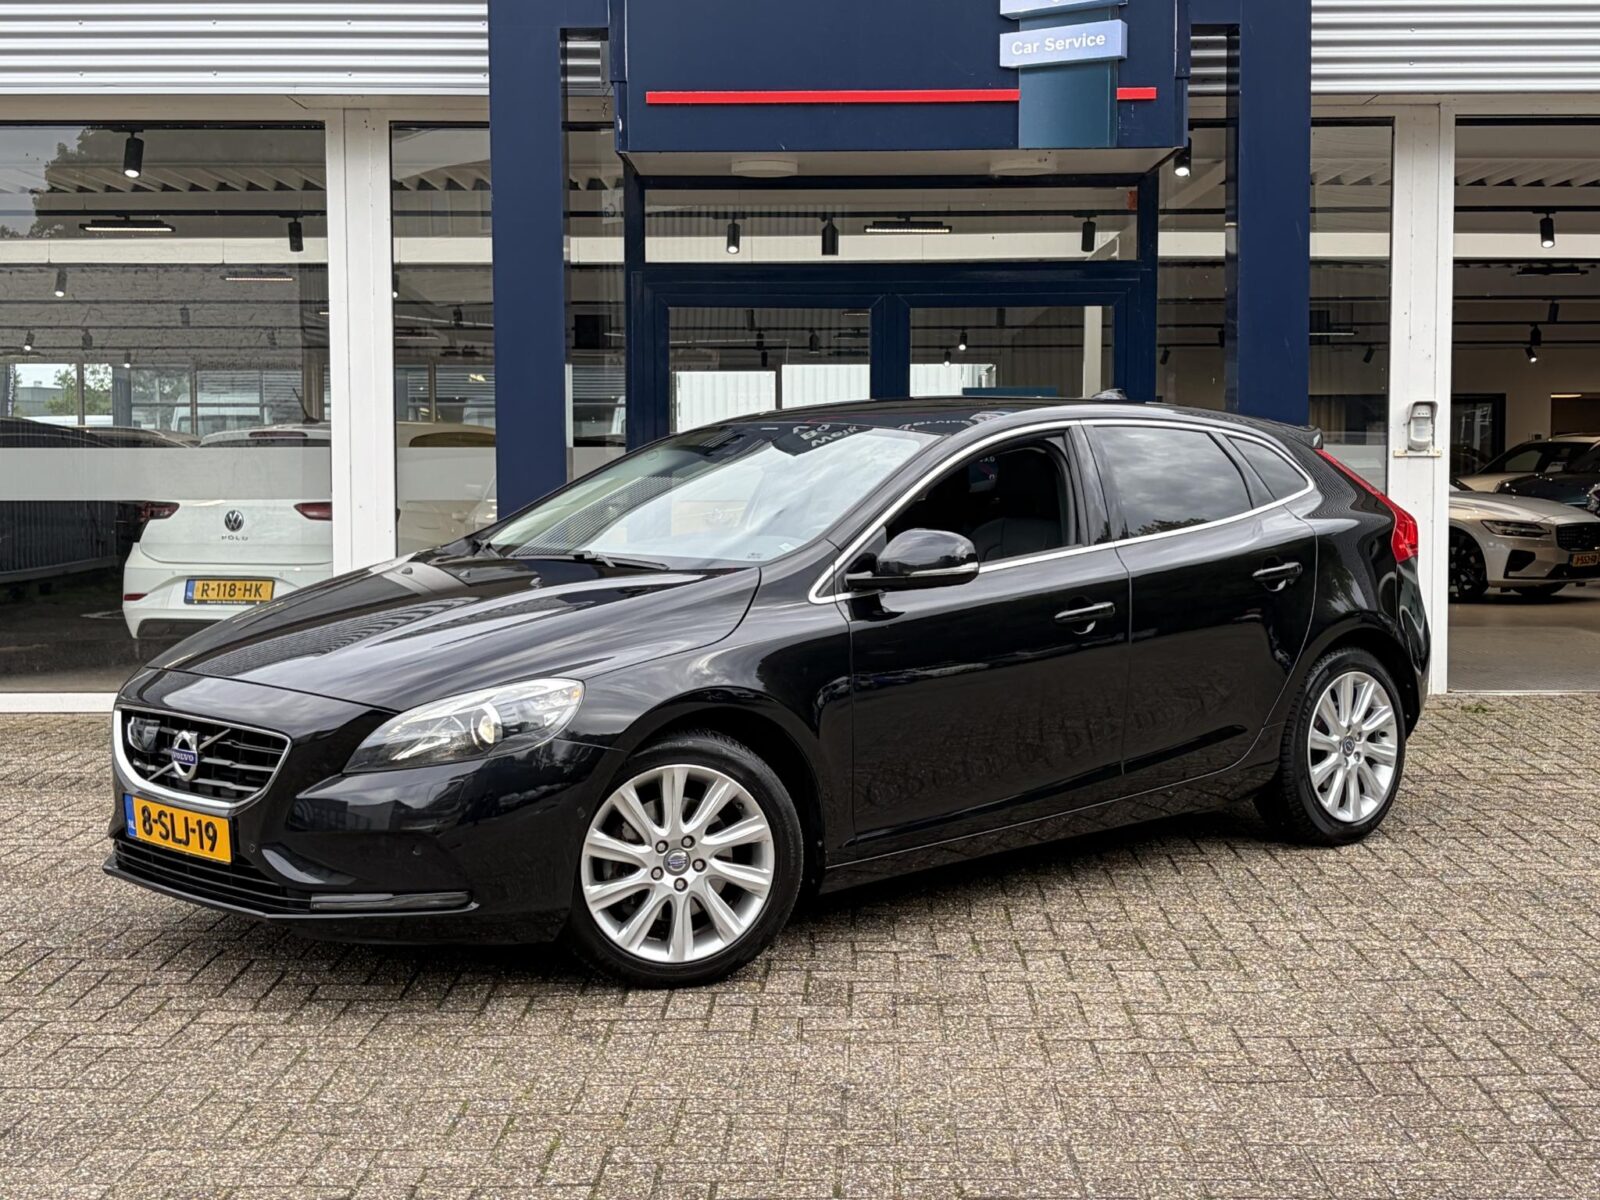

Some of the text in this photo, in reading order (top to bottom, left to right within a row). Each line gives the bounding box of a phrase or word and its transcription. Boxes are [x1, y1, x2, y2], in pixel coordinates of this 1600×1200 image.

[1011, 33, 1106, 55] Car Service
[201, 583, 263, 598] R-118-HK
[172, 751, 195, 762] VOLVO
[141, 805, 218, 853] 8-SLJ-19
